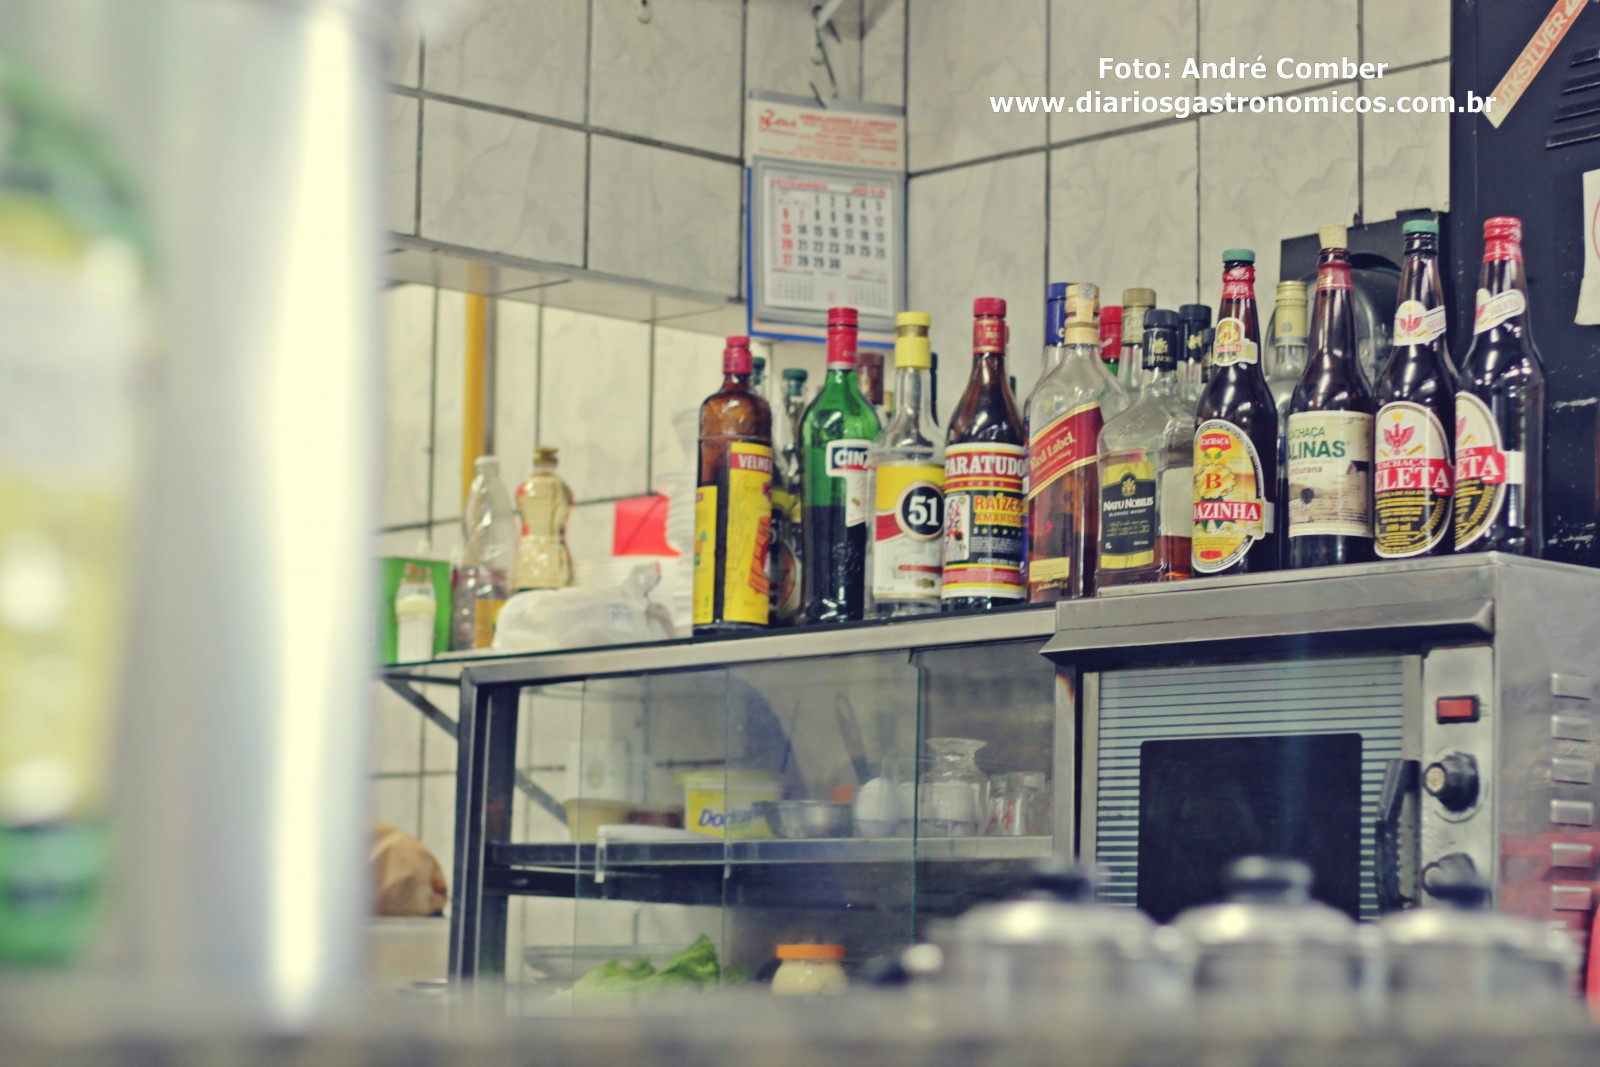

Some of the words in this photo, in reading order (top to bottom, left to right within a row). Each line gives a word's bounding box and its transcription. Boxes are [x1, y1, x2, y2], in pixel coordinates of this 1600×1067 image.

[945, 456, 1024, 476] PARATUDO
[1205, 473, 1222, 489] B
[908, 496, 939, 526] 51
[1103, 499, 1124, 511] NATU
